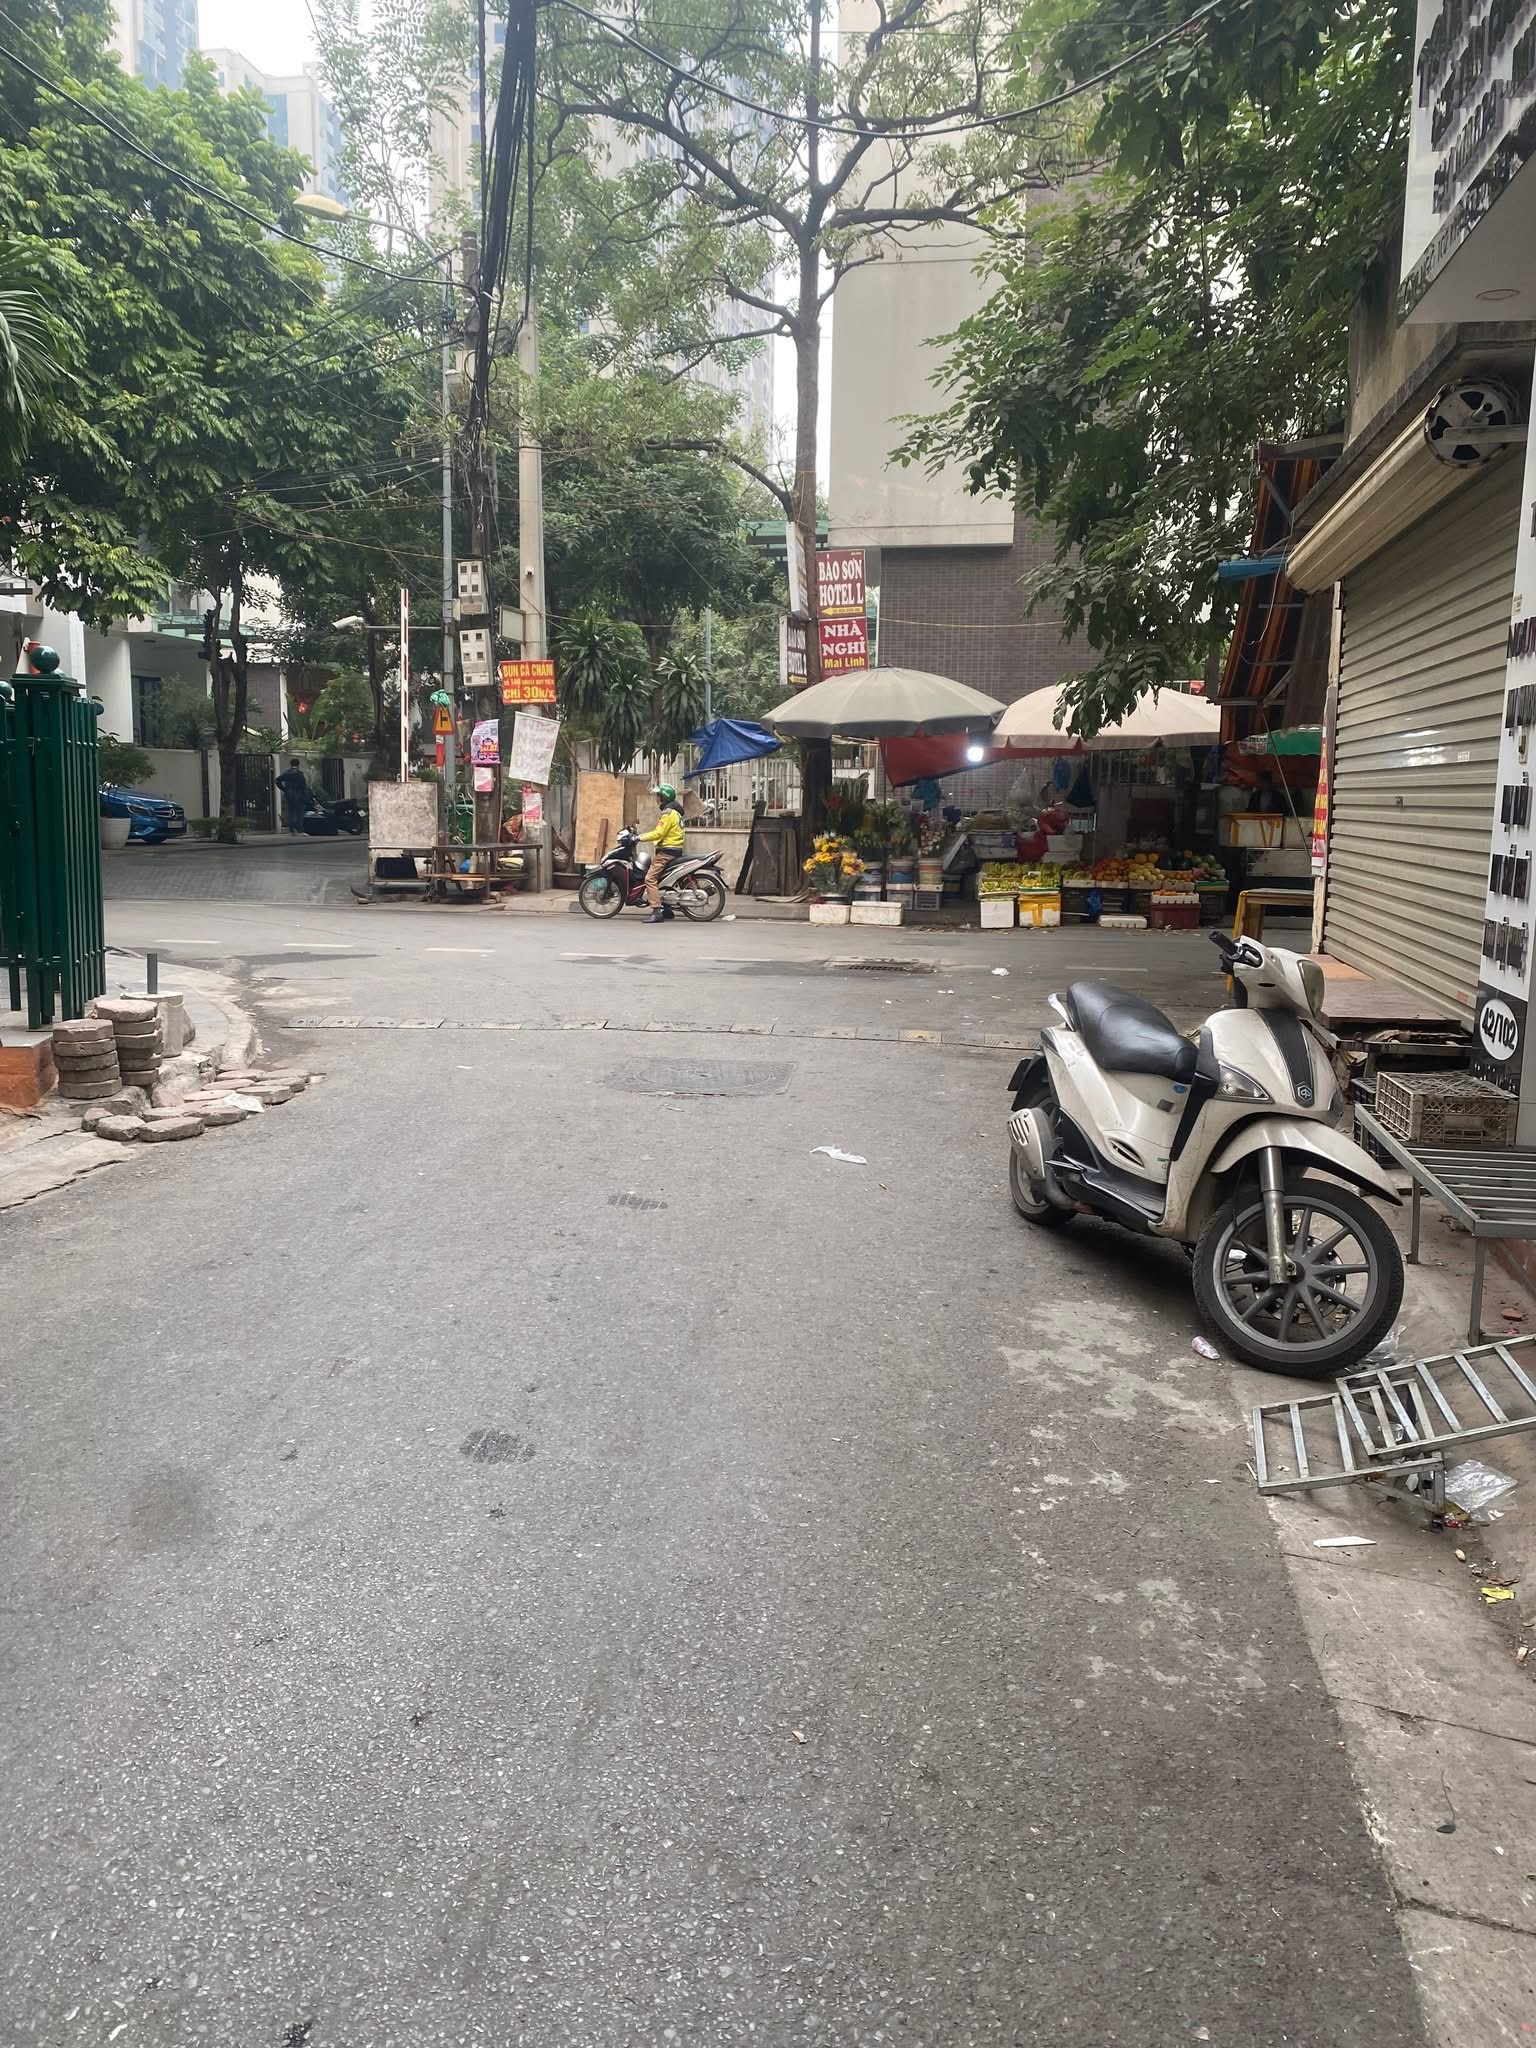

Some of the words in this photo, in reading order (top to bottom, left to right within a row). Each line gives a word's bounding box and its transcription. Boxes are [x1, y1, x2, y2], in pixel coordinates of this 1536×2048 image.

[818, 553, 840, 581] BẢO
[818, 583, 855, 606] HOTEL
[823, 620, 862, 638] NHÀ
[822, 636, 866, 656] NGHỈ
[824, 657, 842, 669] Mai
[844, 656, 865, 668] Linh
[1482, 1007, 1516, 1051] 42/102
